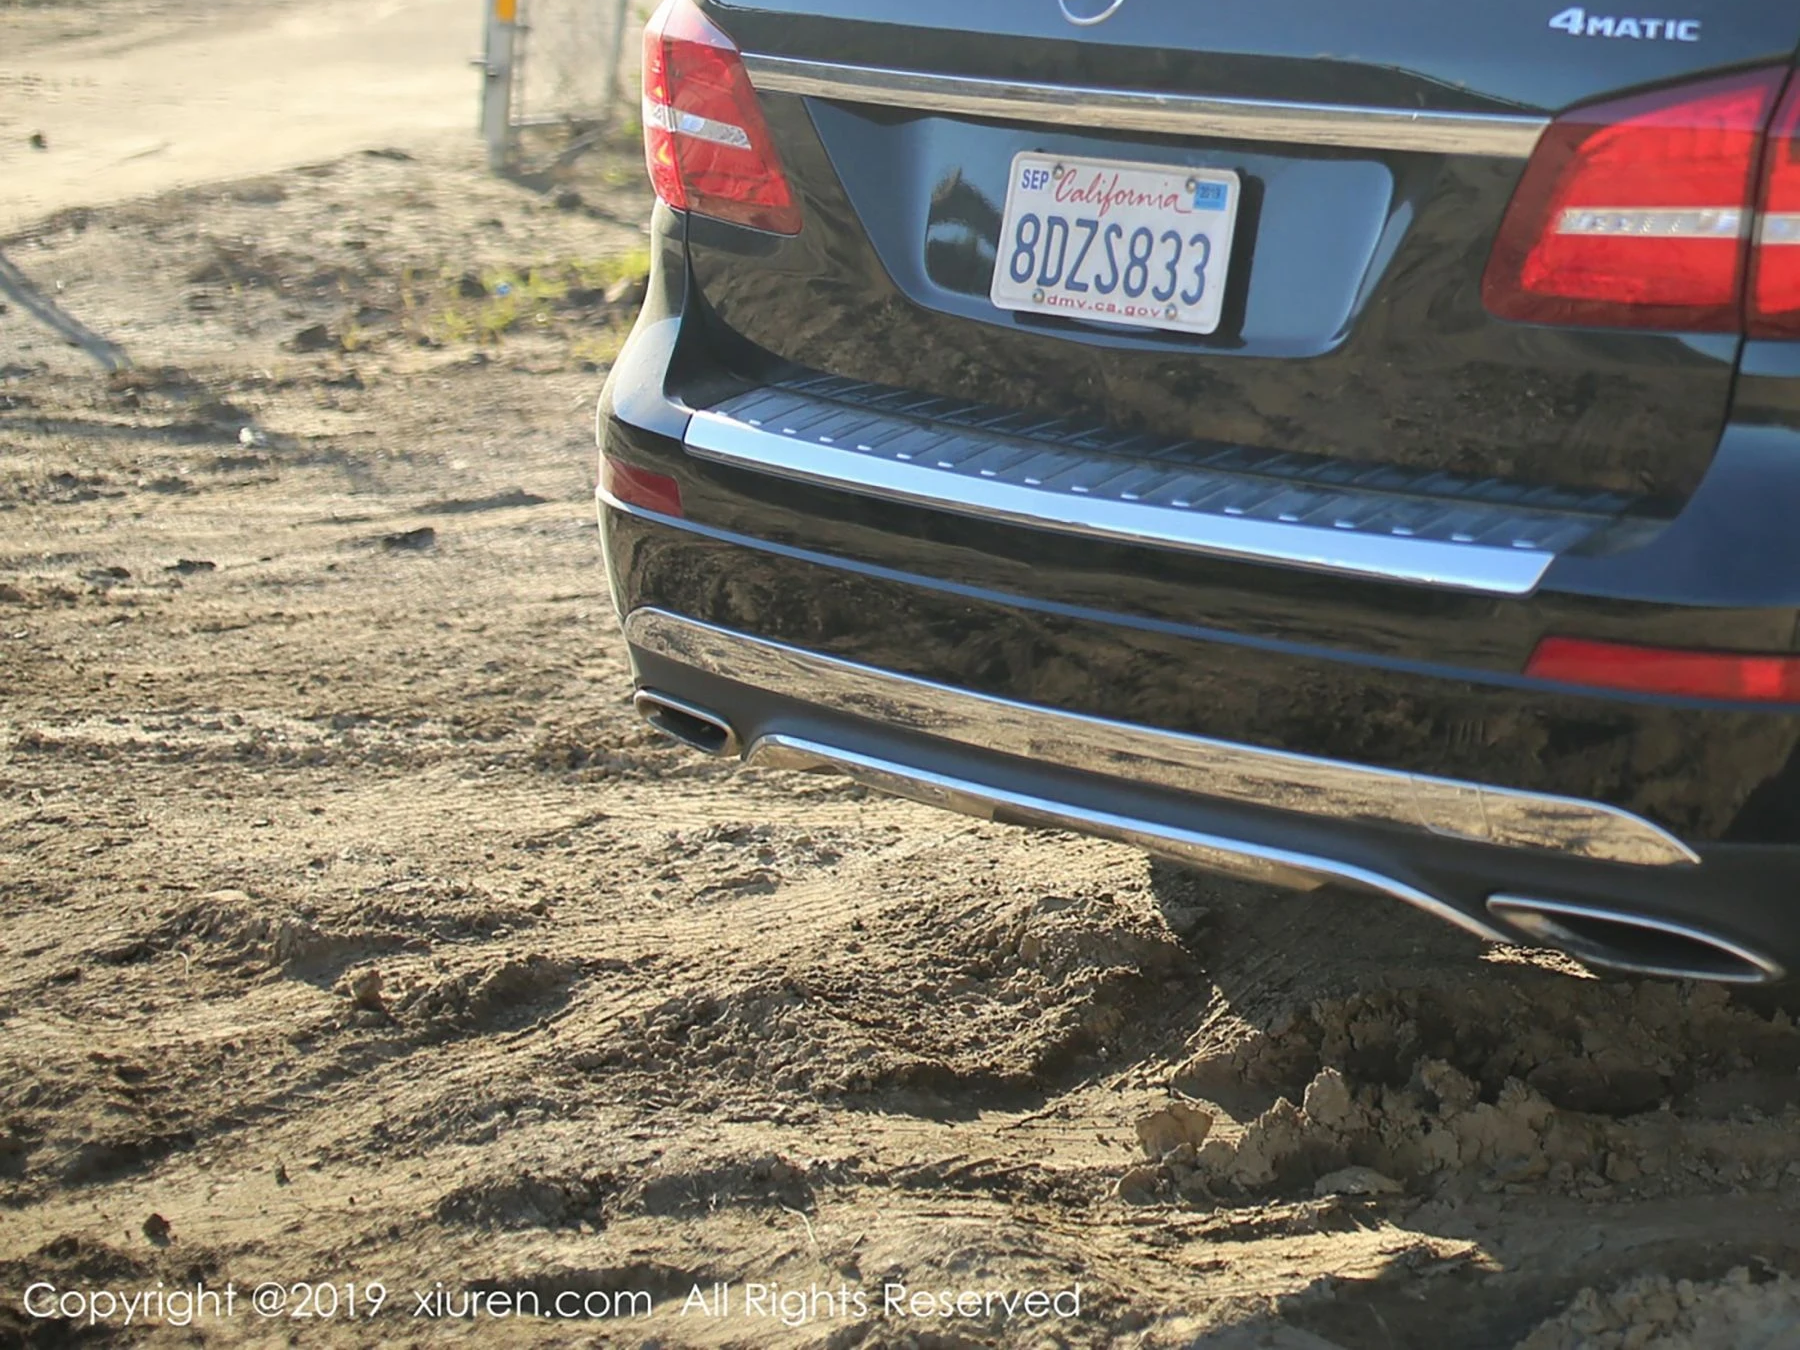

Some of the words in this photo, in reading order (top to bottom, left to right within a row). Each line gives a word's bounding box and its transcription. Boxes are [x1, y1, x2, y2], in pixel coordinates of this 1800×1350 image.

[1549, 7, 1701, 41] 4MATIC
[1021, 169, 1049, 190] SEP
[1055, 169, 1192, 217] California
[1009, 213, 1211, 306] 8DZS833
[1047, 295, 1160, 317] dmv.ca.gov
